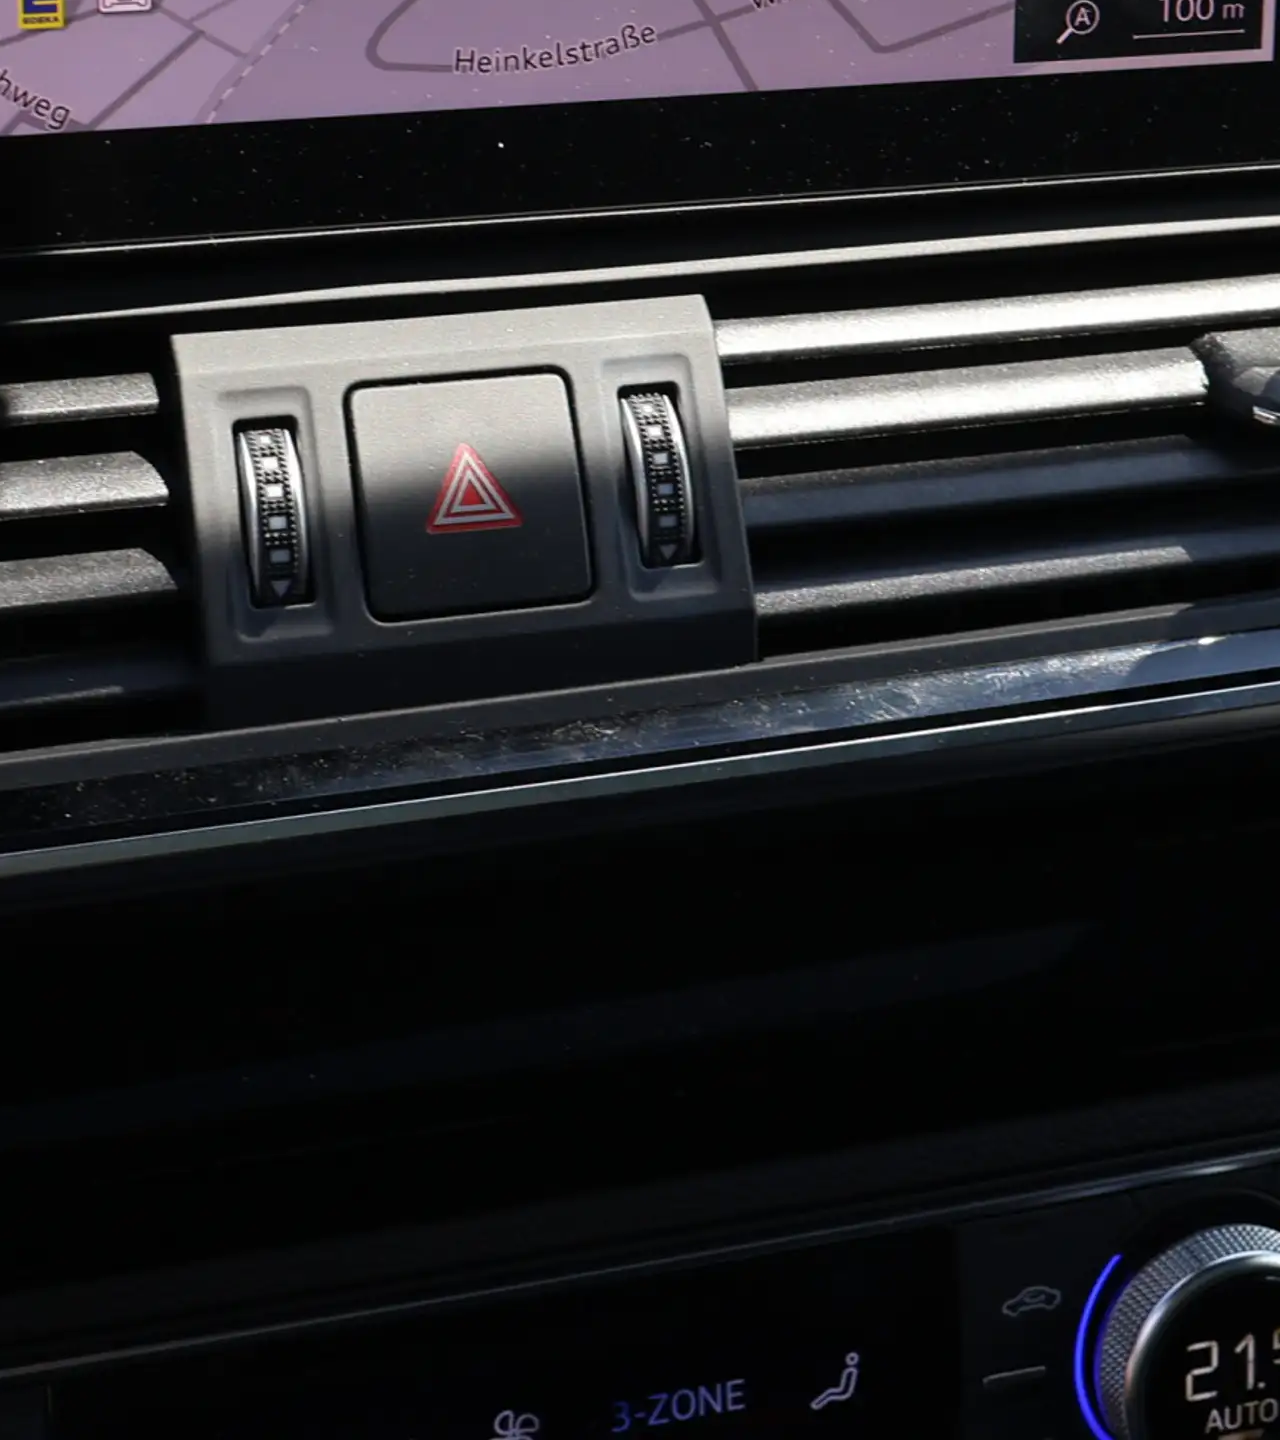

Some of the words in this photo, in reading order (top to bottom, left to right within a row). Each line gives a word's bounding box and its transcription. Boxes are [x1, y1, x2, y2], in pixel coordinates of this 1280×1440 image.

[1222, 2, 1245, 19] m
[453, 24, 656, 74] Heinkelstraße
[610, 1378, 747, 1433] 3-ZONE
[1204, 1397, 1279, 1434] AUTO
